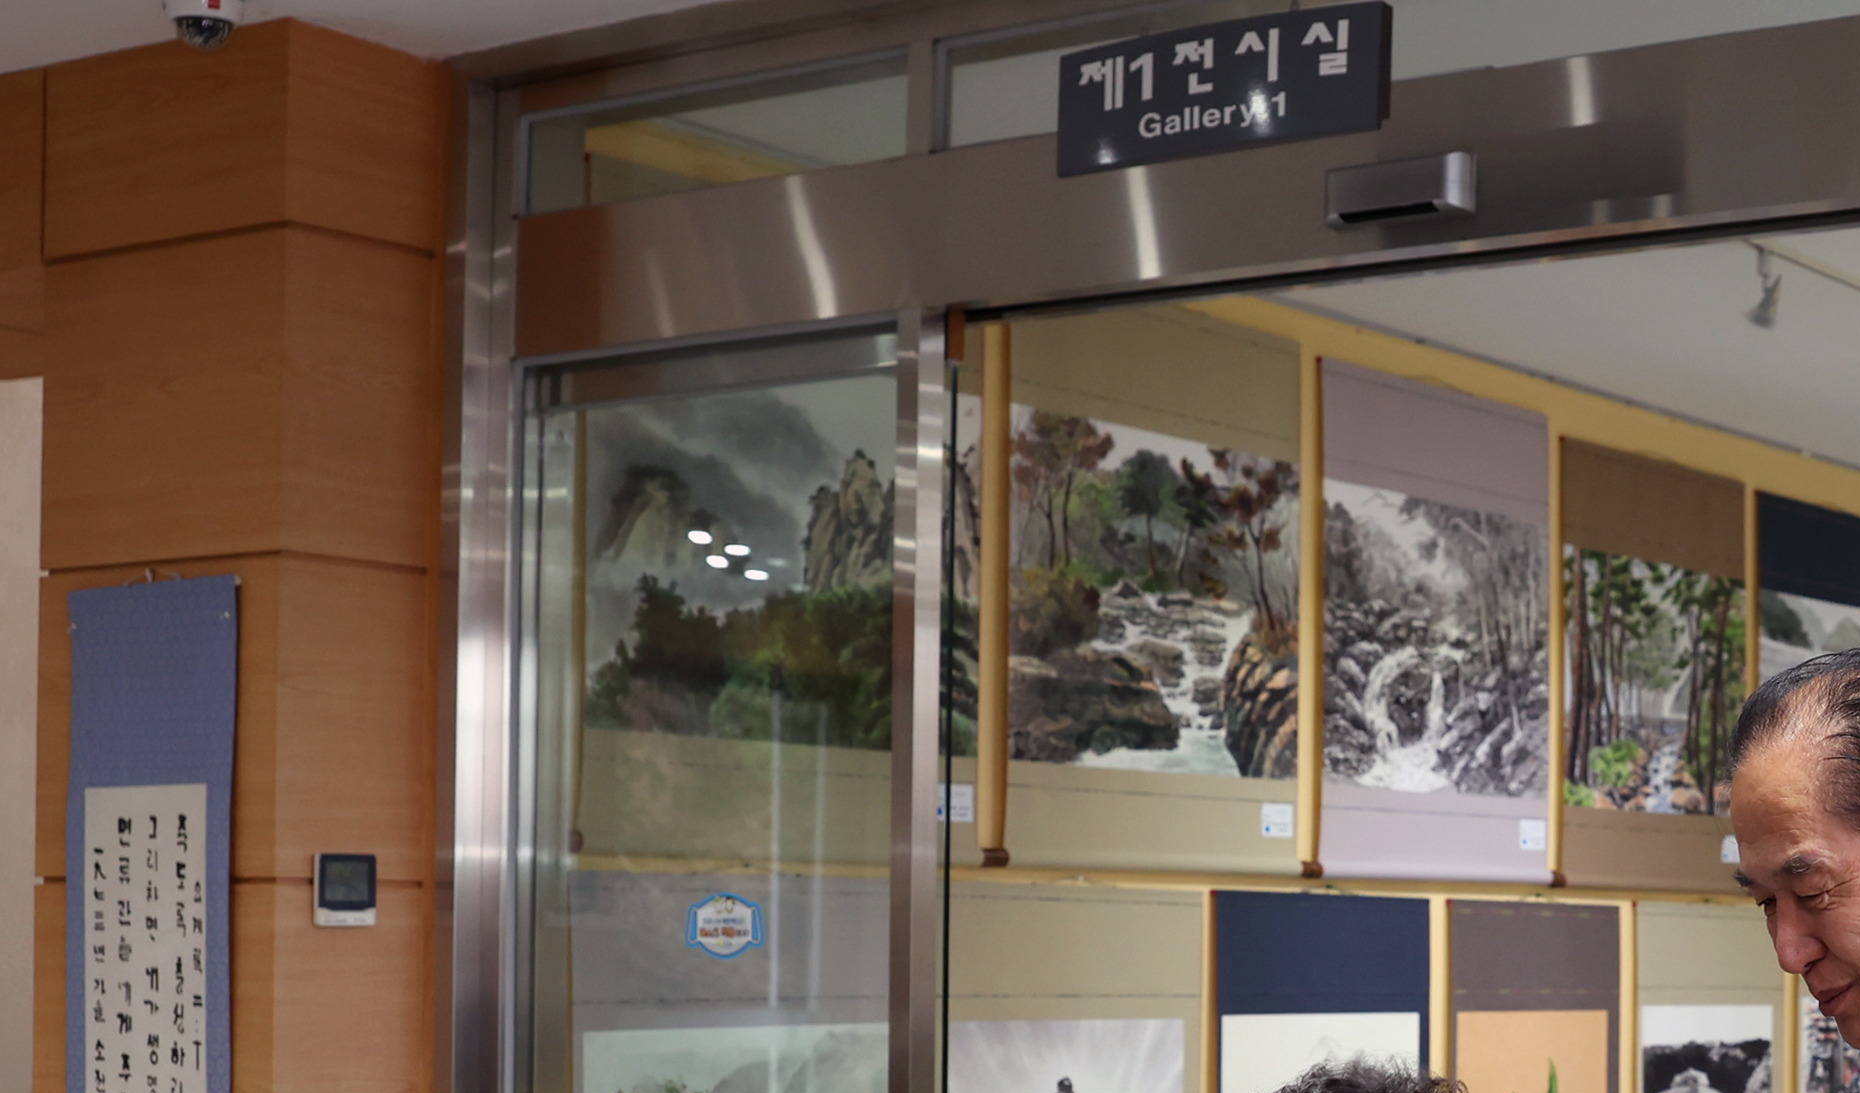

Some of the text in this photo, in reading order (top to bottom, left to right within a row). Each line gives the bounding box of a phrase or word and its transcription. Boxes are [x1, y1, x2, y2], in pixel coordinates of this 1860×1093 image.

[1078, 18, 1350, 112] 제1 전시실
[1138, 91, 1286, 139] Gallery 1
